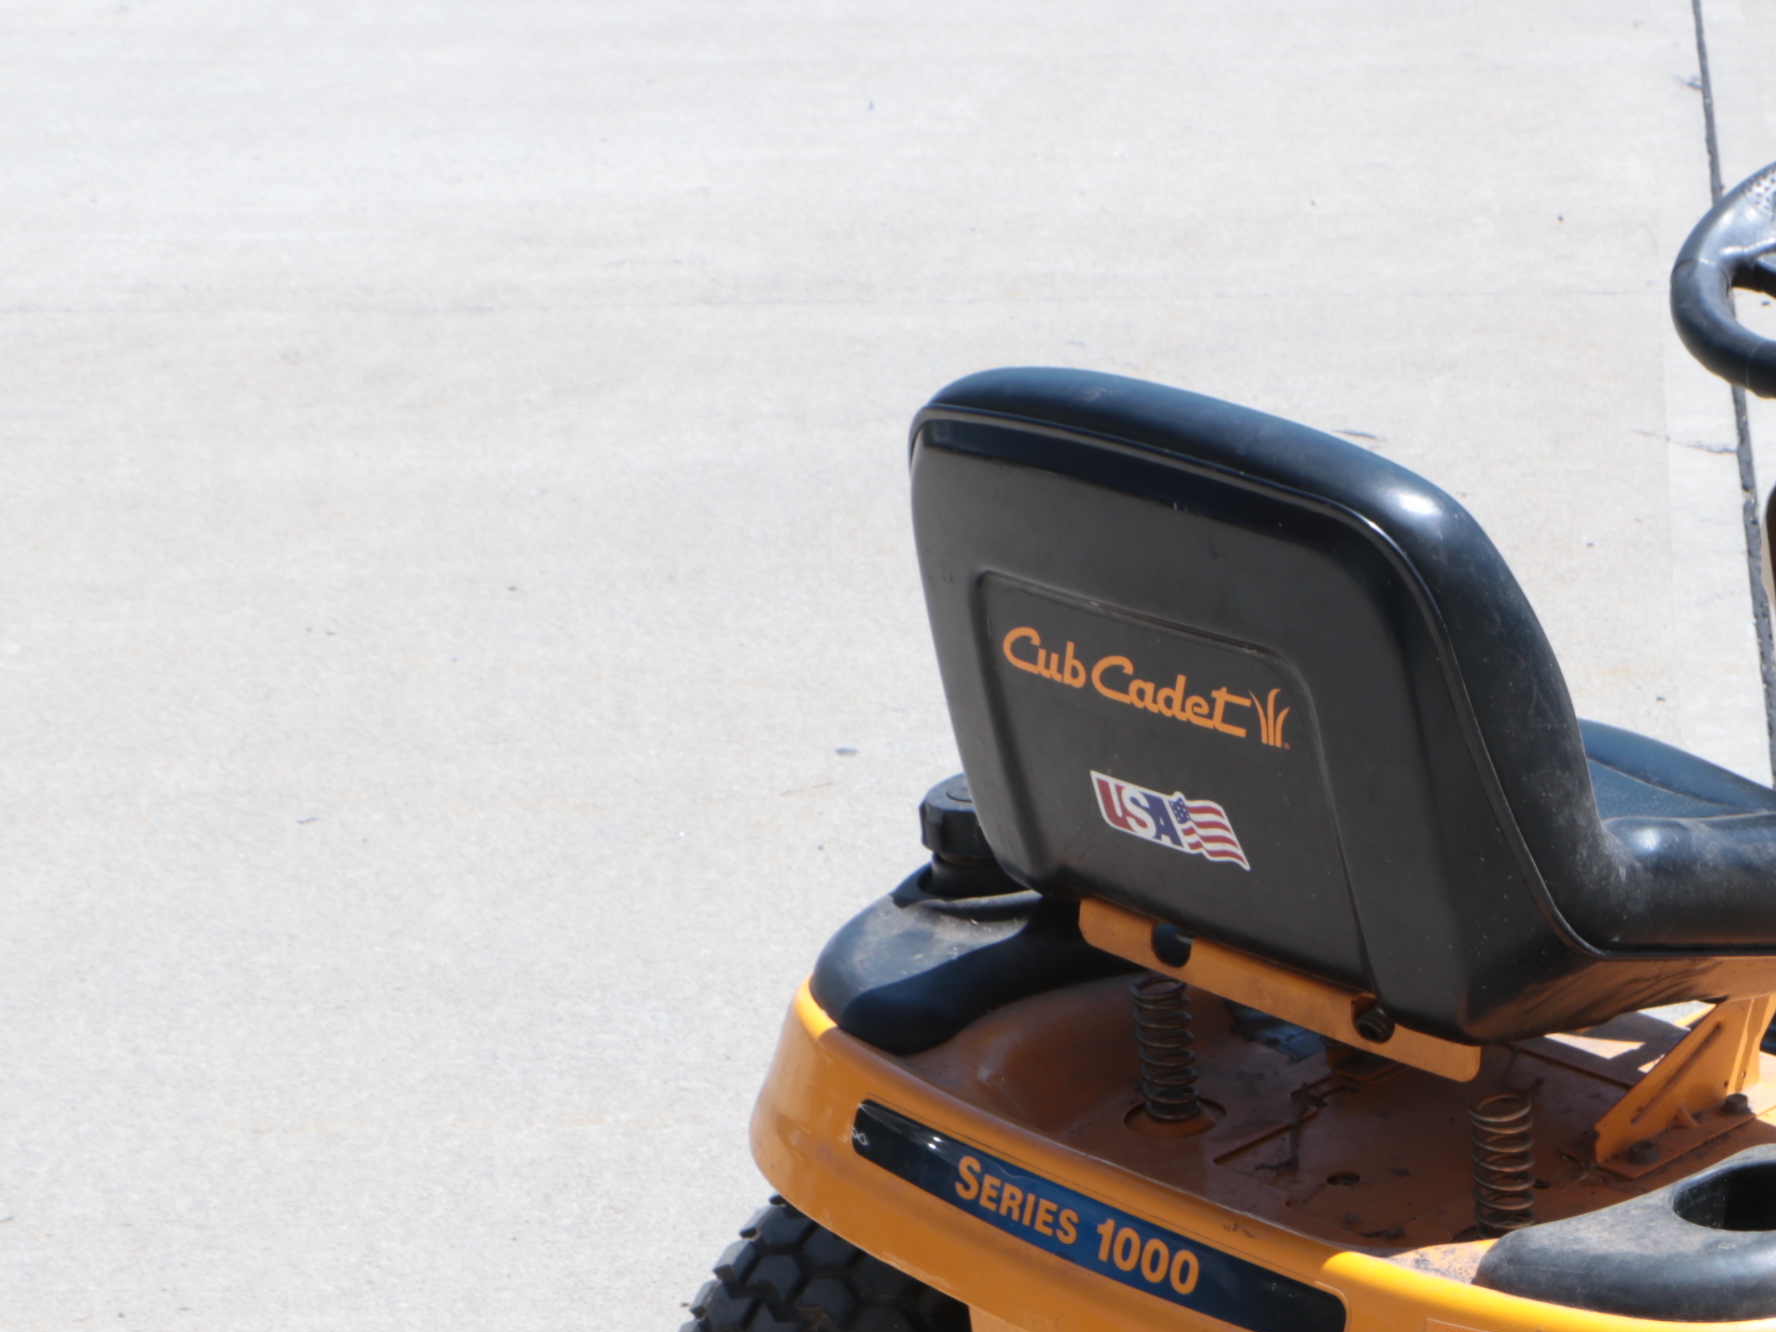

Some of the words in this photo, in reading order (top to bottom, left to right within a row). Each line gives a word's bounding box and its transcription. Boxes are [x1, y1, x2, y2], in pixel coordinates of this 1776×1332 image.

[1002, 626, 1086, 689] Cub
[1091, 655, 1252, 738] Cadet
[1095, 776, 1185, 850] USA
[954, 1155, 1079, 1246] SERIES
[1096, 1219, 1199, 1296] 1000
